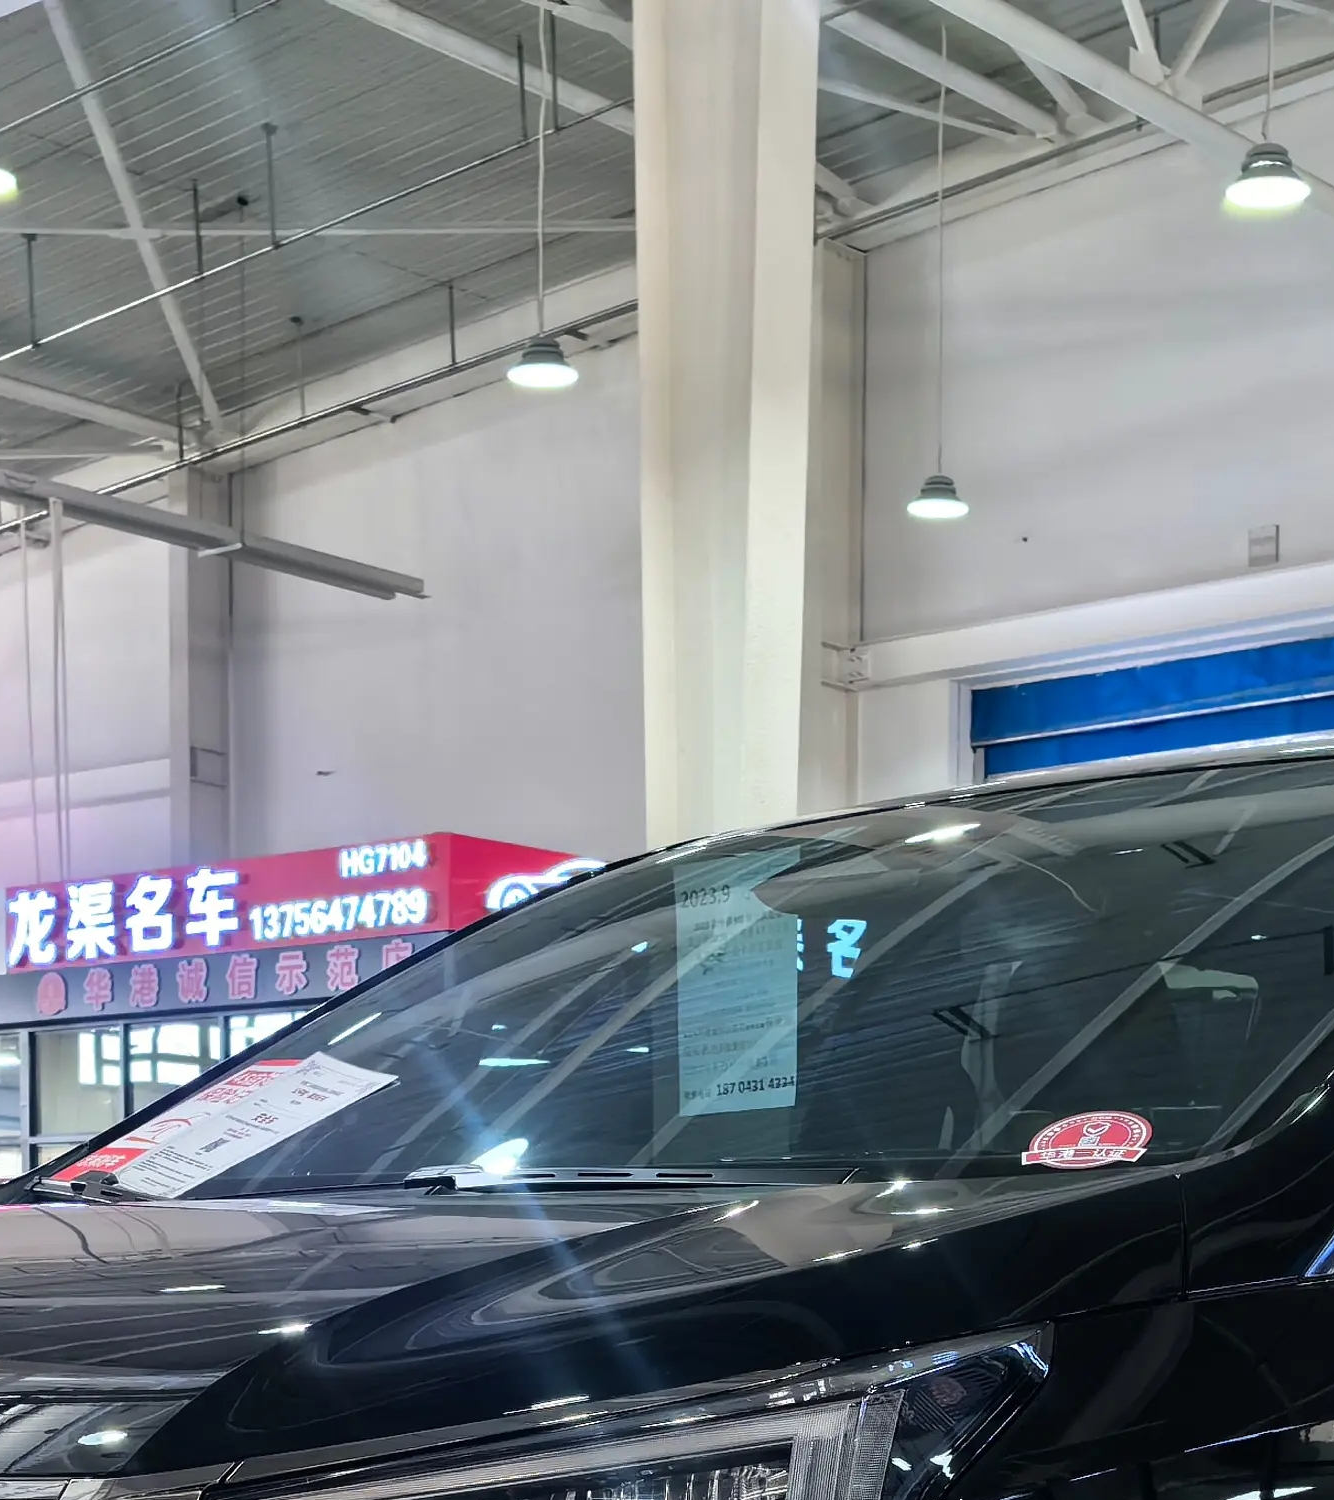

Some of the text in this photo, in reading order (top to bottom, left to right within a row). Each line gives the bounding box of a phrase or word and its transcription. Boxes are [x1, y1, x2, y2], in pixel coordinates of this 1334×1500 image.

[339, 839, 427, 878] HG7104
[8, 866, 240, 967] 龙渠名车
[249, 888, 429, 942] 13756474789
